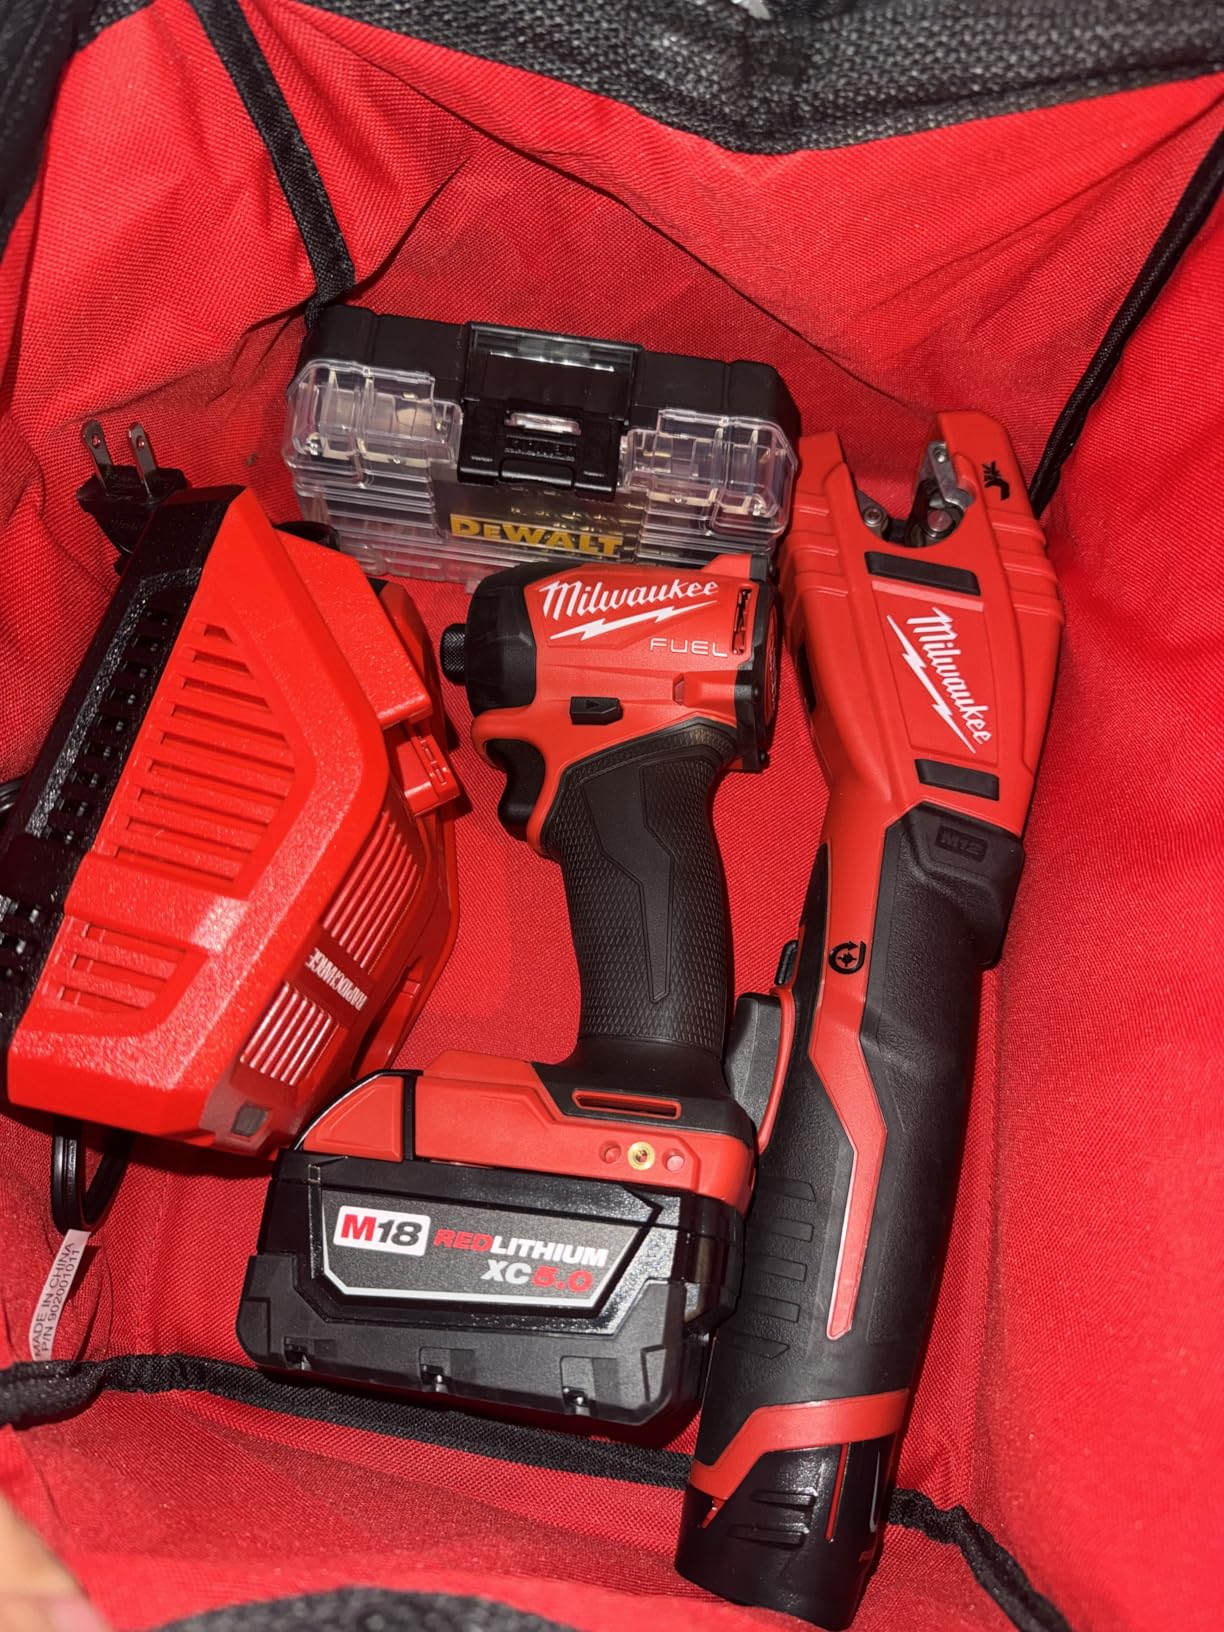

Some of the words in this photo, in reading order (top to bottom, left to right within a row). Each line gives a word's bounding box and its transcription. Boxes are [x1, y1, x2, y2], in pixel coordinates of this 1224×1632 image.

[539, 579, 719, 621] Milwaukee
[650, 637, 728, 657] FUEL
[906, 607, 992, 744] Milwaukee
[340, 1213, 423, 1247] M18
[480, 1258, 593, 1293] XC5.0
[31, 1312, 47, 1357] MADE
[41, 1293, 54, 1308] IN
[50, 1242, 75, 1289] CHINA
[41, 1326, 53, 1352] P/N
